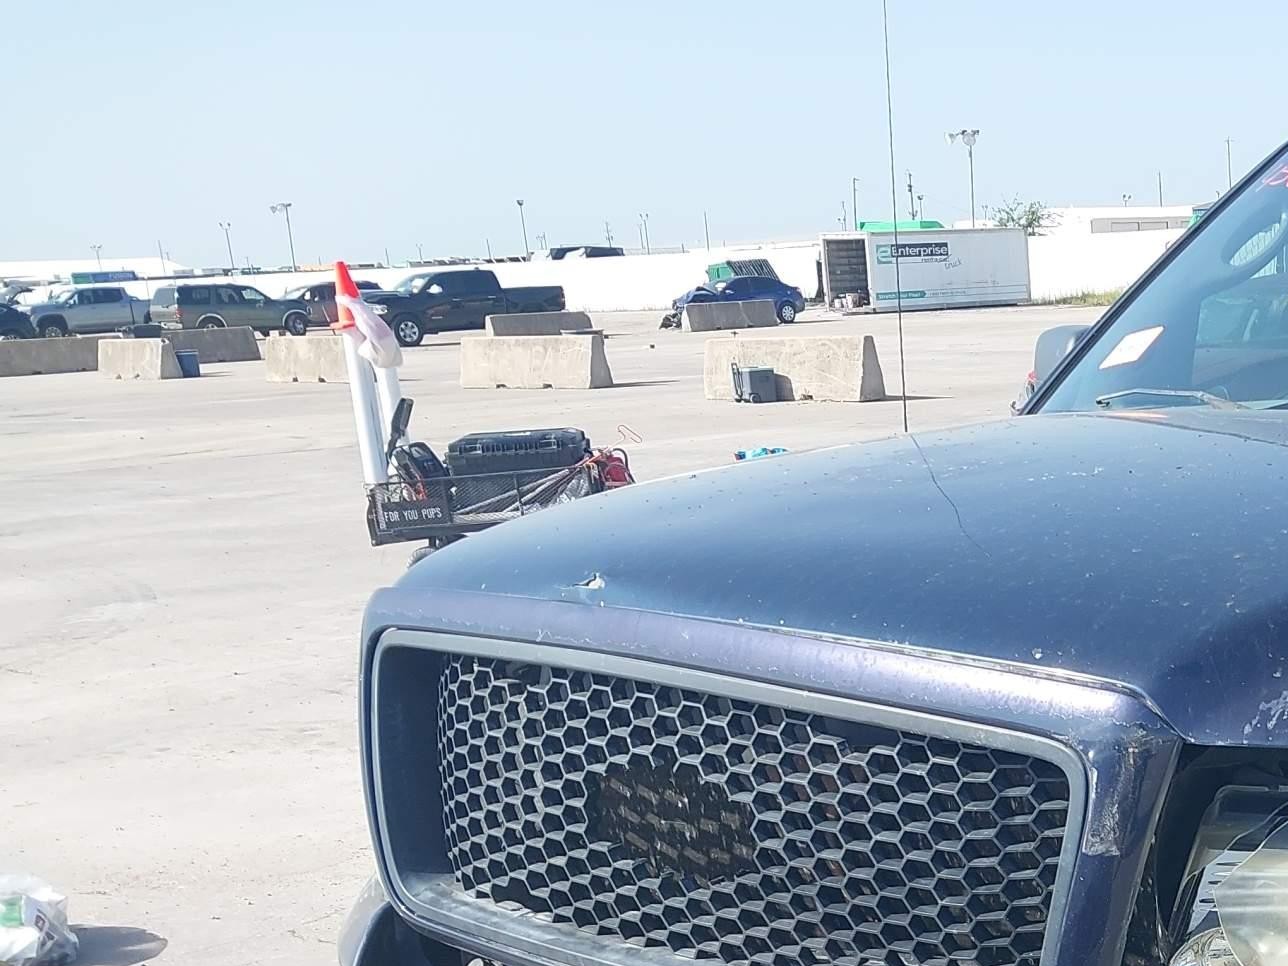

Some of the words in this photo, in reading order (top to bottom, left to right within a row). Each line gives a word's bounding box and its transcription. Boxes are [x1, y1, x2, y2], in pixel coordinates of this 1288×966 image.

[891, 244, 948, 257] Enterprise
[384, 511, 400, 523] FOR
[402, 509, 419, 521] YOU
[421, 507, 442, 520] POPS
